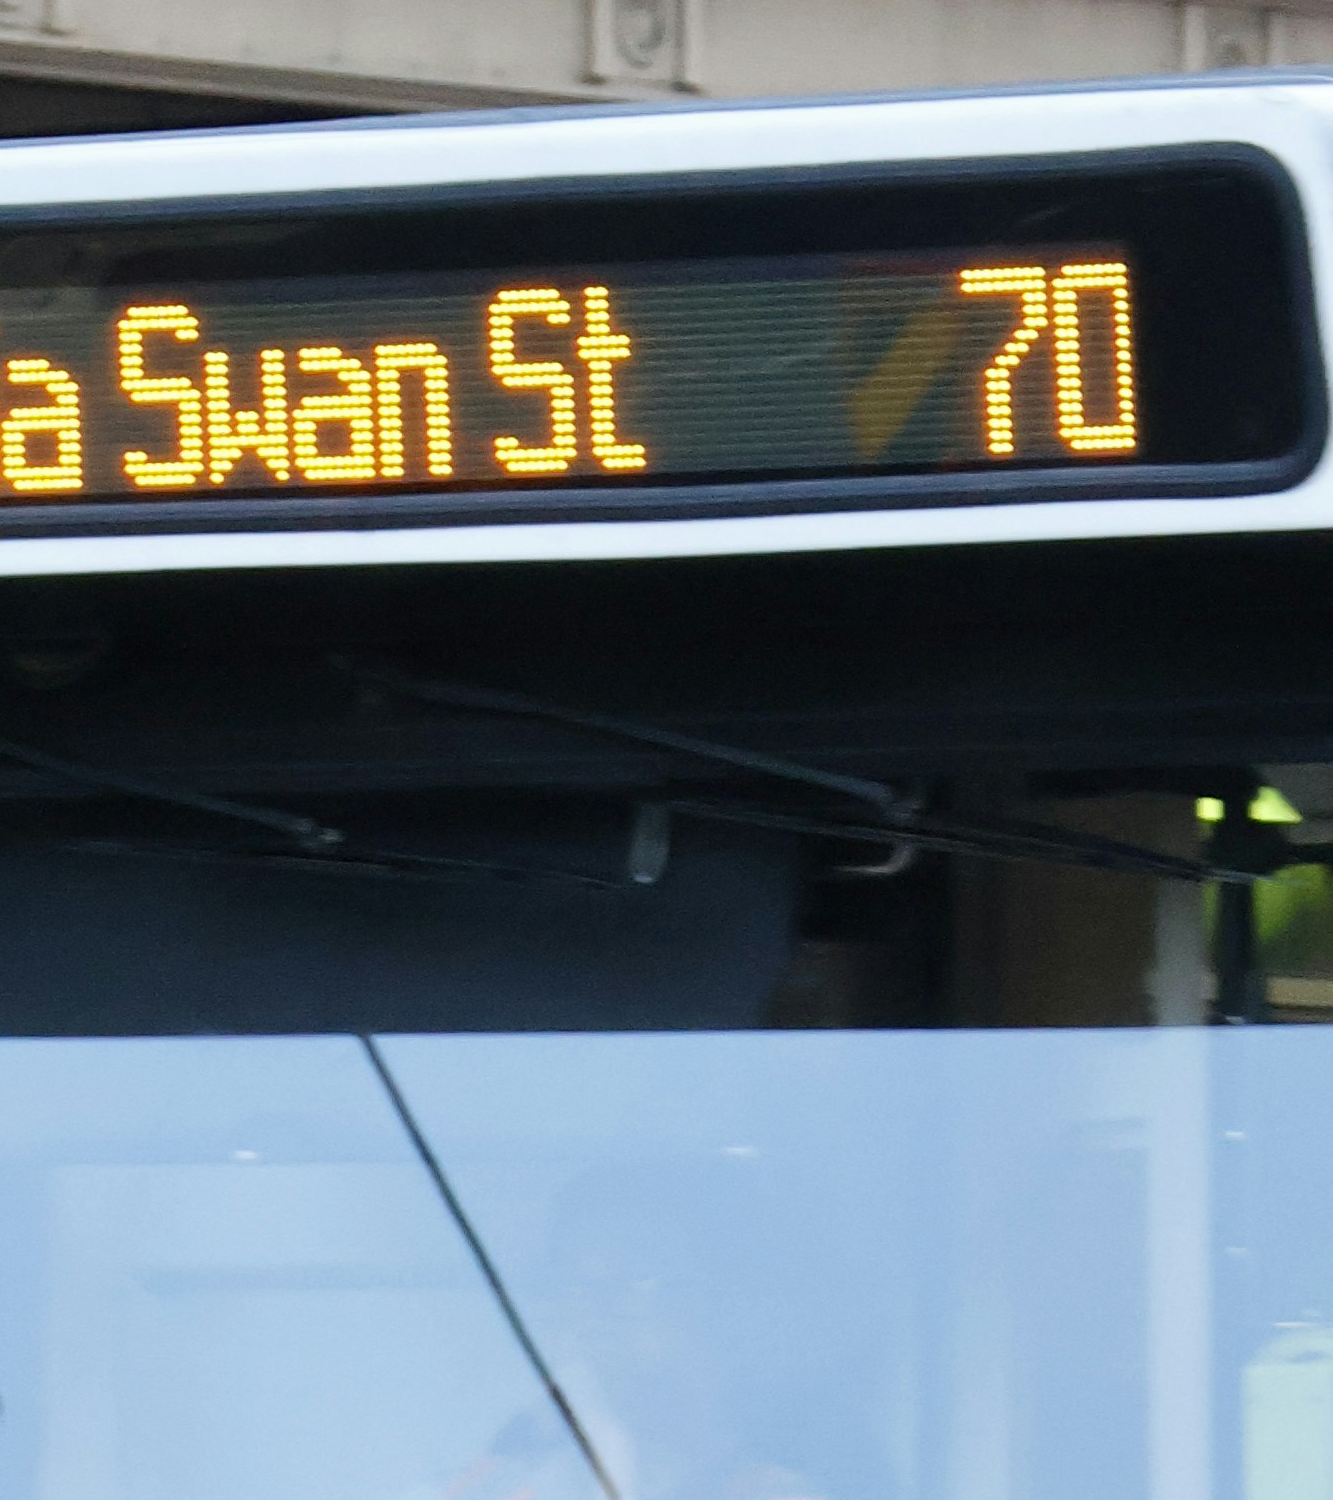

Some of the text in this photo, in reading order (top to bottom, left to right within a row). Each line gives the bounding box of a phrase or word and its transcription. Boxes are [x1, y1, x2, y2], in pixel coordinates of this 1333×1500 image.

[118, 304, 453, 487] Swan
[488, 286, 646, 473] St
[959, 262, 1136, 455] 70
